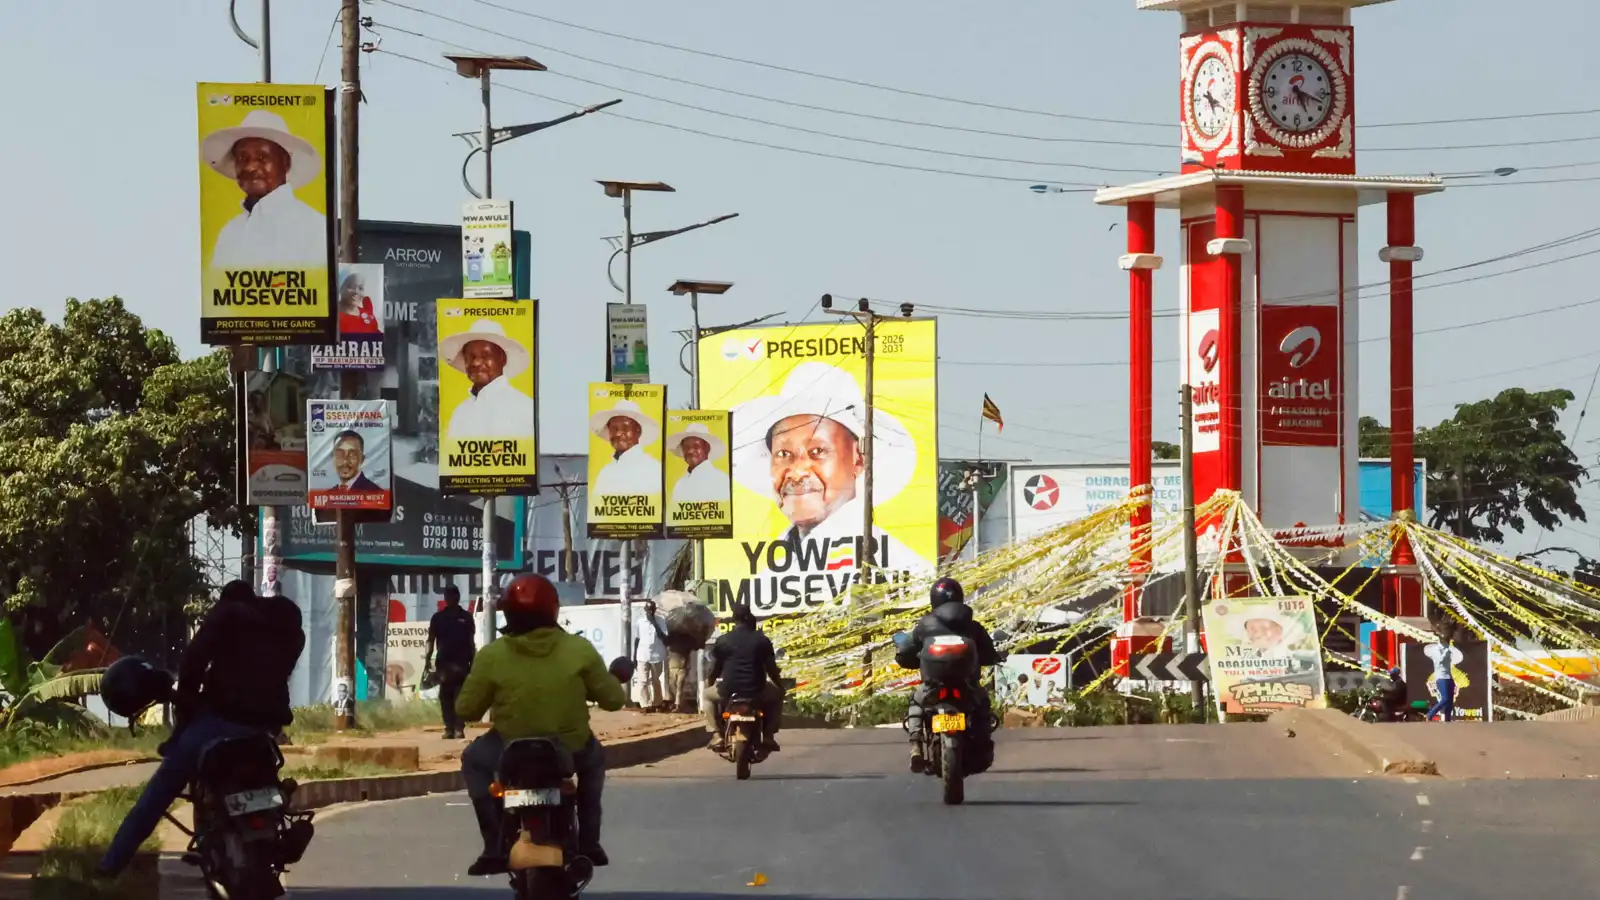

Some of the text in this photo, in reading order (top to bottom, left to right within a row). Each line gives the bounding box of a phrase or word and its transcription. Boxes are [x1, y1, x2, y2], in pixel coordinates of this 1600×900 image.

[1292, 60, 1303, 72] 12
[1267, 86, 1275, 98] 9
[234, 95, 301, 106] PRESIDENT
[1293, 114, 1301, 125] 6
[463, 214, 508, 222] MWAWULE
[385, 248, 441, 263] ARROW
[225, 270, 305, 288] YOWERI
[213, 288, 317, 306] MUSEVENI
[464, 307, 514, 317] PRESIDENT
[216, 320, 316, 329] PROTECTING THE GAINS
[313, 340, 383, 357] ZAHRAH
[767, 335, 904, 359] PRESIDEN 2026
[882, 344, 904, 353] 2031
[1193, 381, 1220, 406] airte
[1269, 376, 1332, 400] airtel
[1280, 406, 1317, 415] REASON
[458, 440, 517, 453] YOWERI
[448, 453, 526, 467] MUSEVENI
[314, 495, 328, 507] MP
[602, 495, 648, 506] YOWERI
[678, 501, 718, 511] YOWERI
[594, 506, 655, 517] MUSEVENI
[672, 511, 725, 521] MUSEVENI
[423, 525, 447, 537] 0700
[451, 526, 468, 538] 118
[423, 537, 447, 549] 0764
[450, 538, 469, 550] 000
[741, 535, 888, 574] YOWERI
